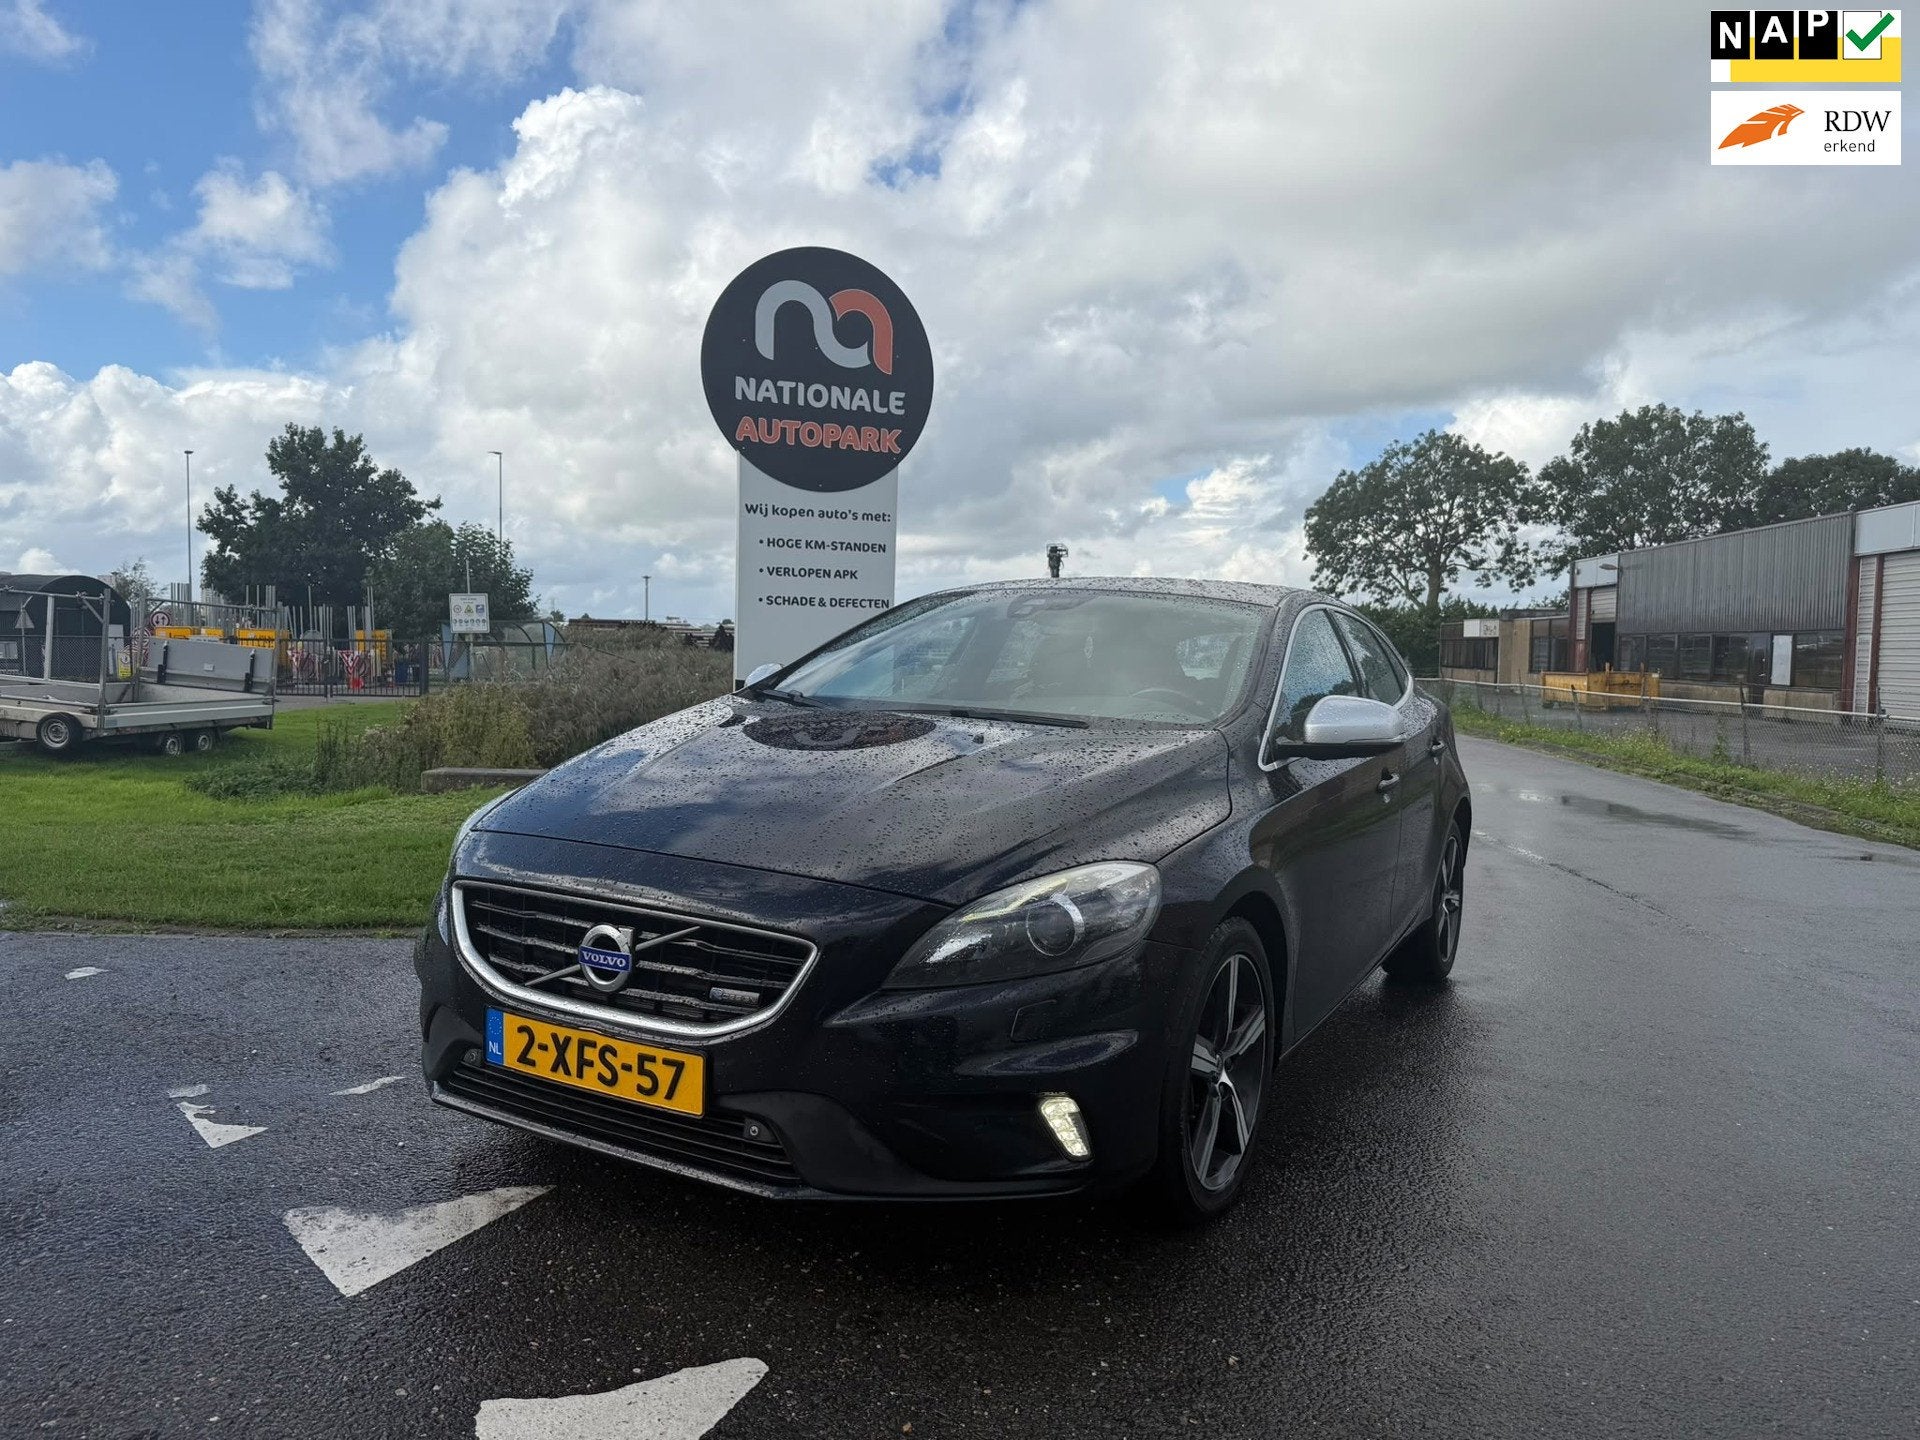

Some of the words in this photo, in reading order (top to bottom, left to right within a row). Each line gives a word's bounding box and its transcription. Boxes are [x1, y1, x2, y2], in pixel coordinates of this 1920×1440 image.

[735, 376, 905, 415] NATIONALE
[736, 416, 901, 454] AUTOPARK
[745, 503, 768, 517] Wij
[772, 505, 814, 518] kopen
[818, 510, 858, 521] auto's
[862, 512, 891, 522] met:
[767, 538, 802, 549] HOGE
[805, 540, 887, 553] KM-STANDEN
[767, 566, 831, 579] VERLOPEN
[834, 570, 858, 579] APK
[766, 595, 816, 606] SCHADE
[818, 598, 827, 608] &
[829, 598, 890, 609] DEFECTEN
[582, 950, 627, 968] VOLVO
[488, 1041, 502, 1056] NL
[516, 1025, 686, 1101] 2-XFS-57
